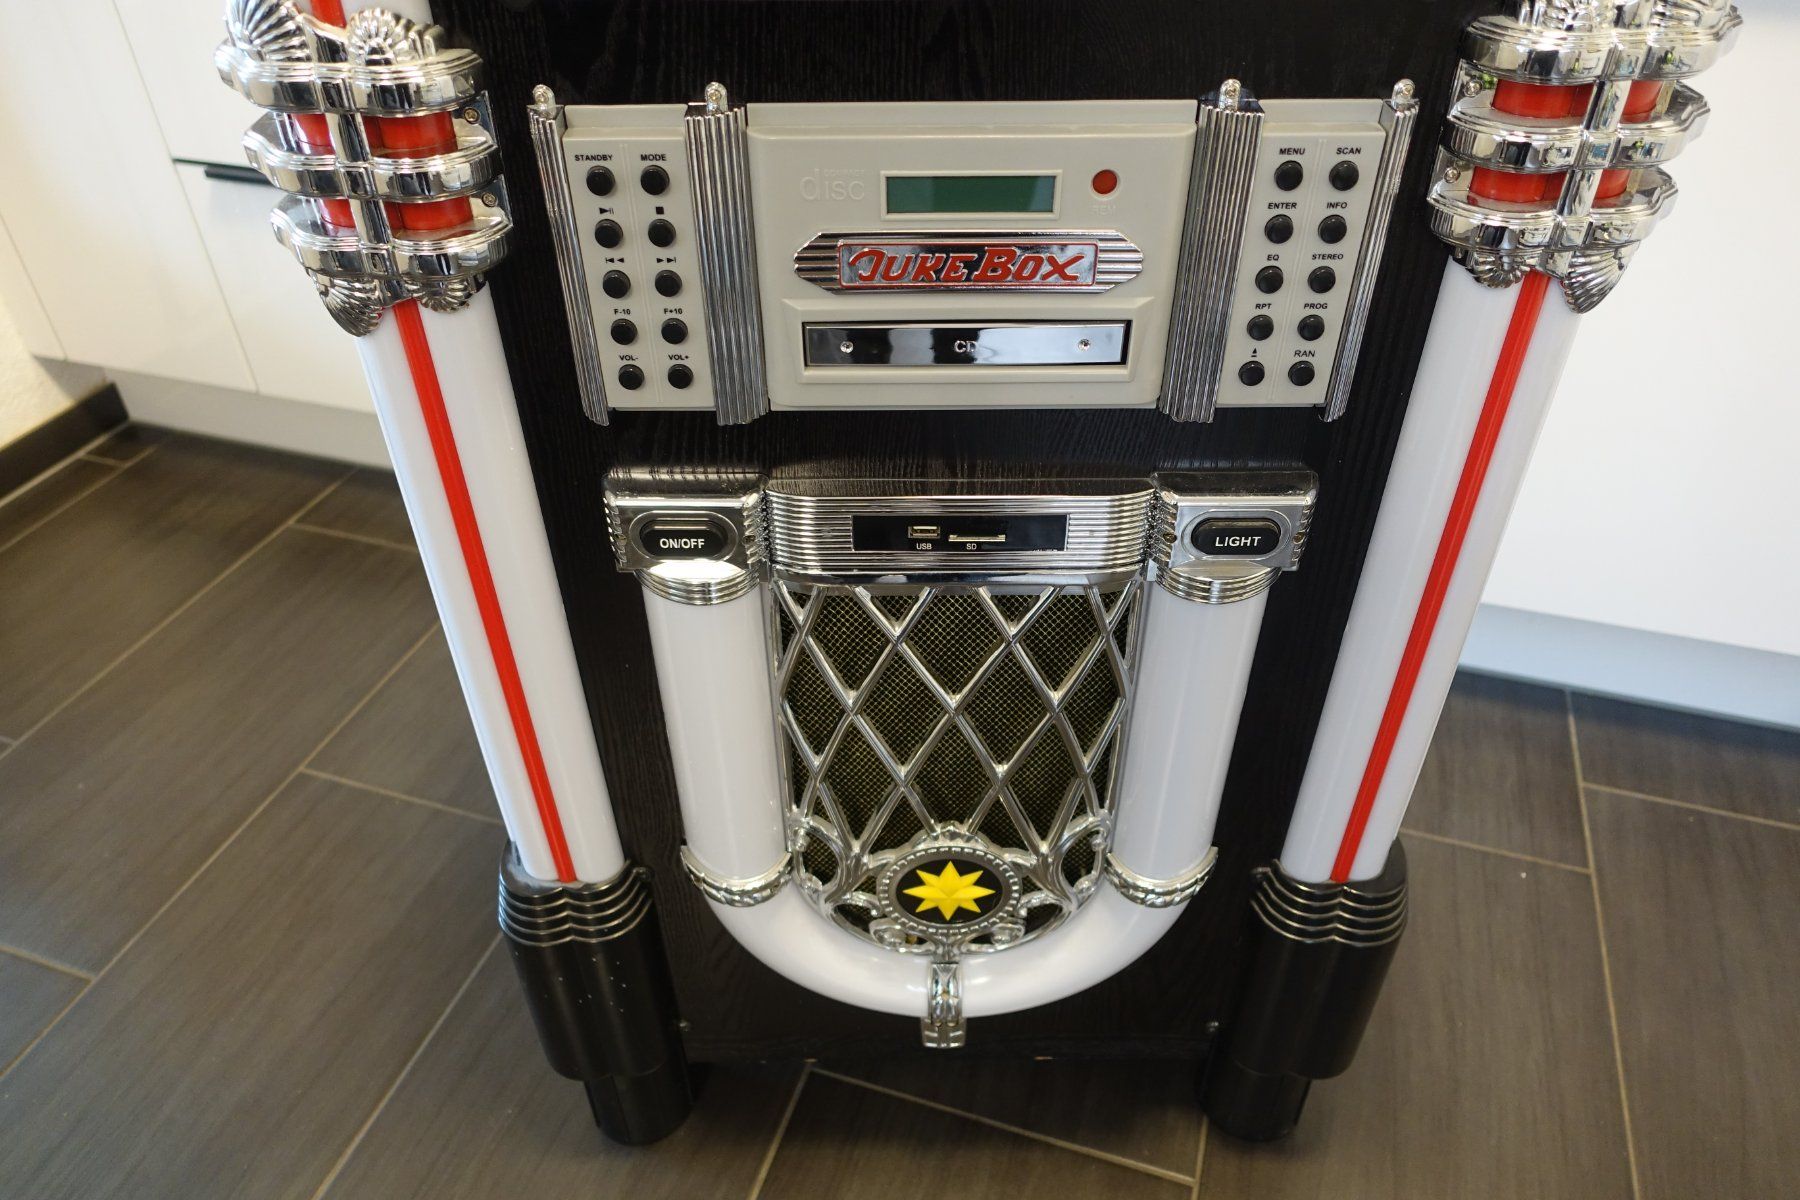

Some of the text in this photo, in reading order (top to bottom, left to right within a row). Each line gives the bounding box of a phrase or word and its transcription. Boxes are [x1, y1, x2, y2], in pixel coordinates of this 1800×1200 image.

[1279, 148, 1306, 156] MENU
[1336, 147, 1362, 155] SCAN
[574, 154, 613, 162] STANDBY
[640, 154, 667, 162] MODE
[954, 340, 978, 353] CD
[659, 536, 706, 551] ON/OFF
[1214, 534, 1262, 548] LIGHT
